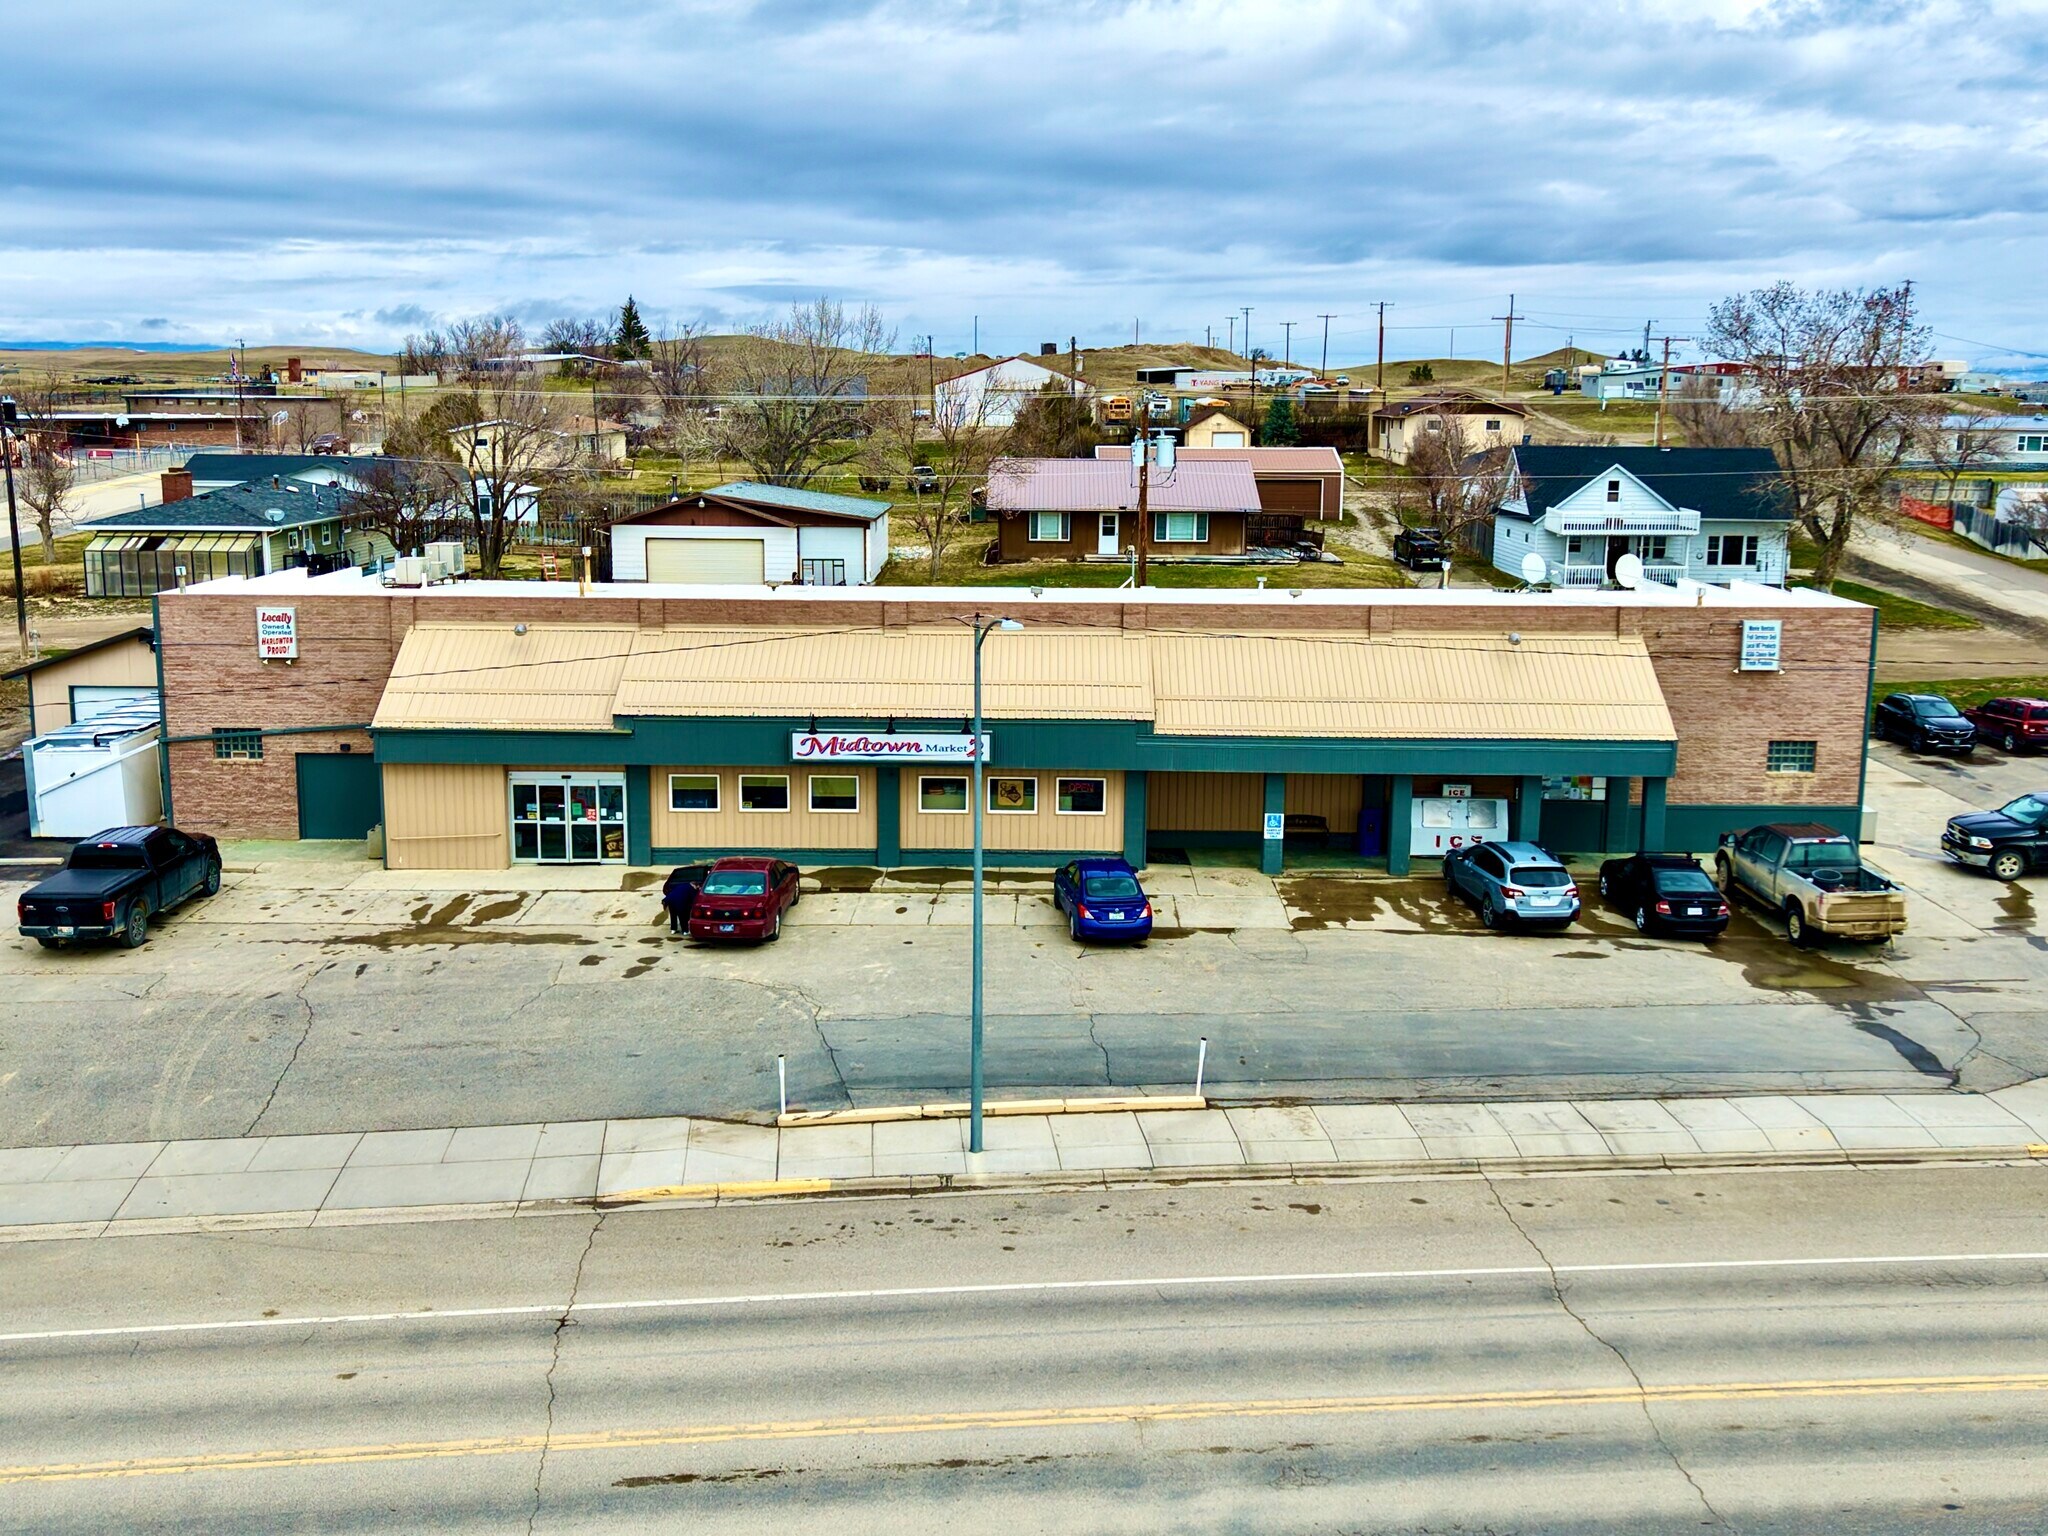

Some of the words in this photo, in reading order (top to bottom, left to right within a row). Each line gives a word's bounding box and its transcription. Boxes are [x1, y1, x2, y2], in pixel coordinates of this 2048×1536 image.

[261, 612, 292, 624] Locally
[267, 646, 290, 655] PROUD!
[796, 735, 923, 757] Midtown
[925, 743, 968, 754] Market
[1068, 782, 1094, 793] OPEN
